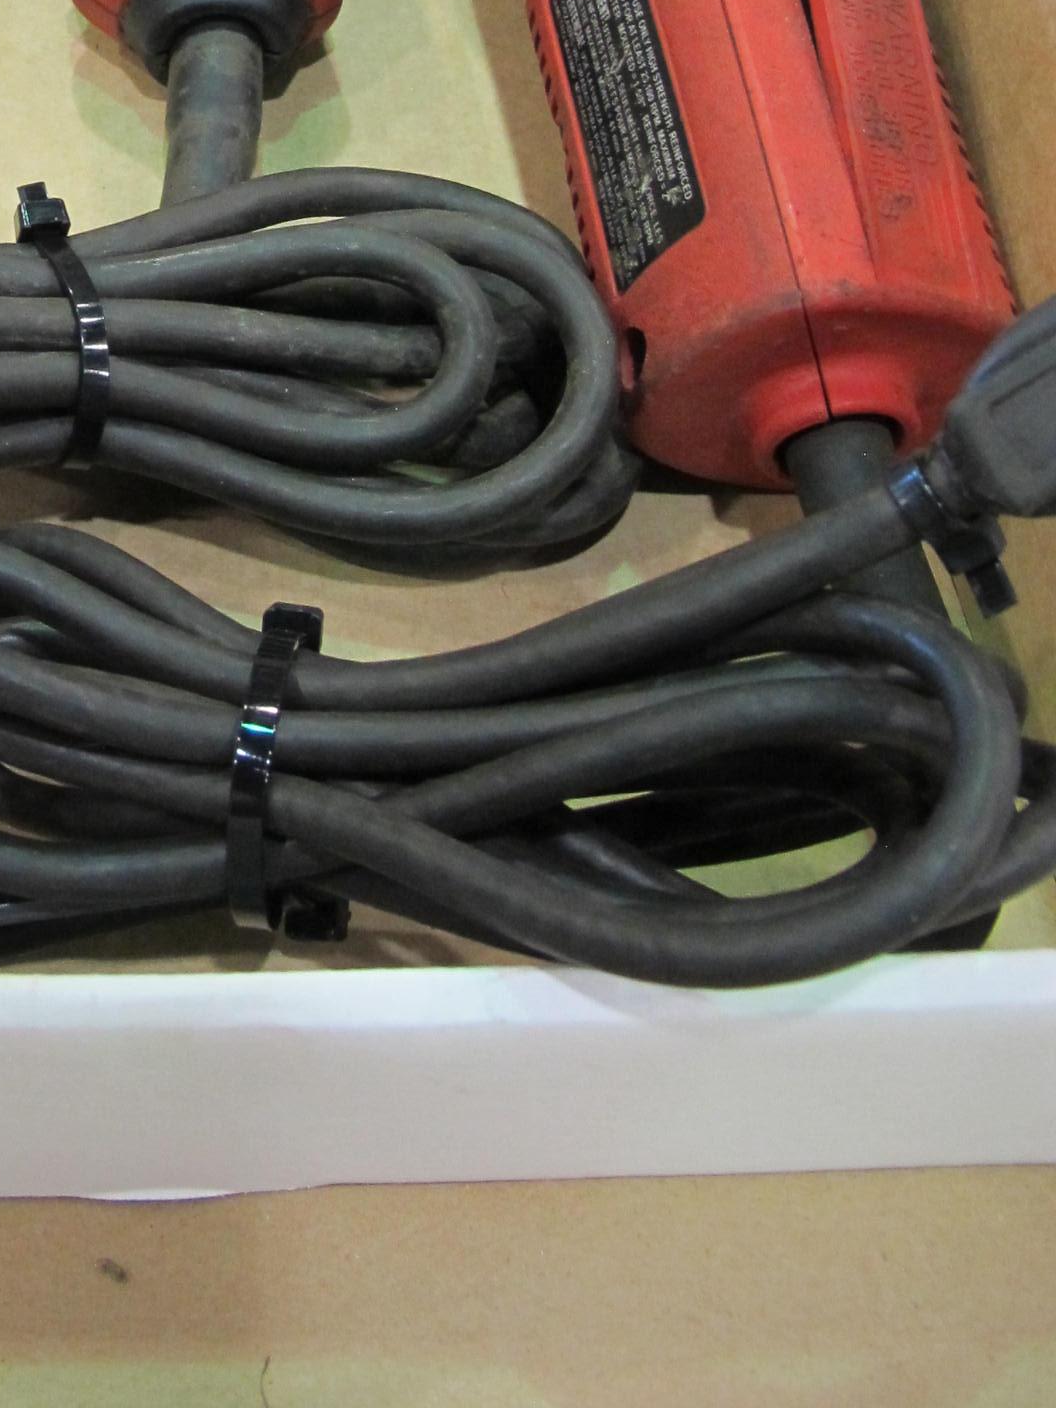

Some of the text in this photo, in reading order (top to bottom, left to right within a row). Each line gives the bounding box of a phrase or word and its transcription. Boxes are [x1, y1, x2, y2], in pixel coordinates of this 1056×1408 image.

[621, 0, 634, 24] FOR
[630, 36, 647, 69] LEAST
[637, 18, 652, 44] ONLY
[644, 45, 659, 73] HIGH
